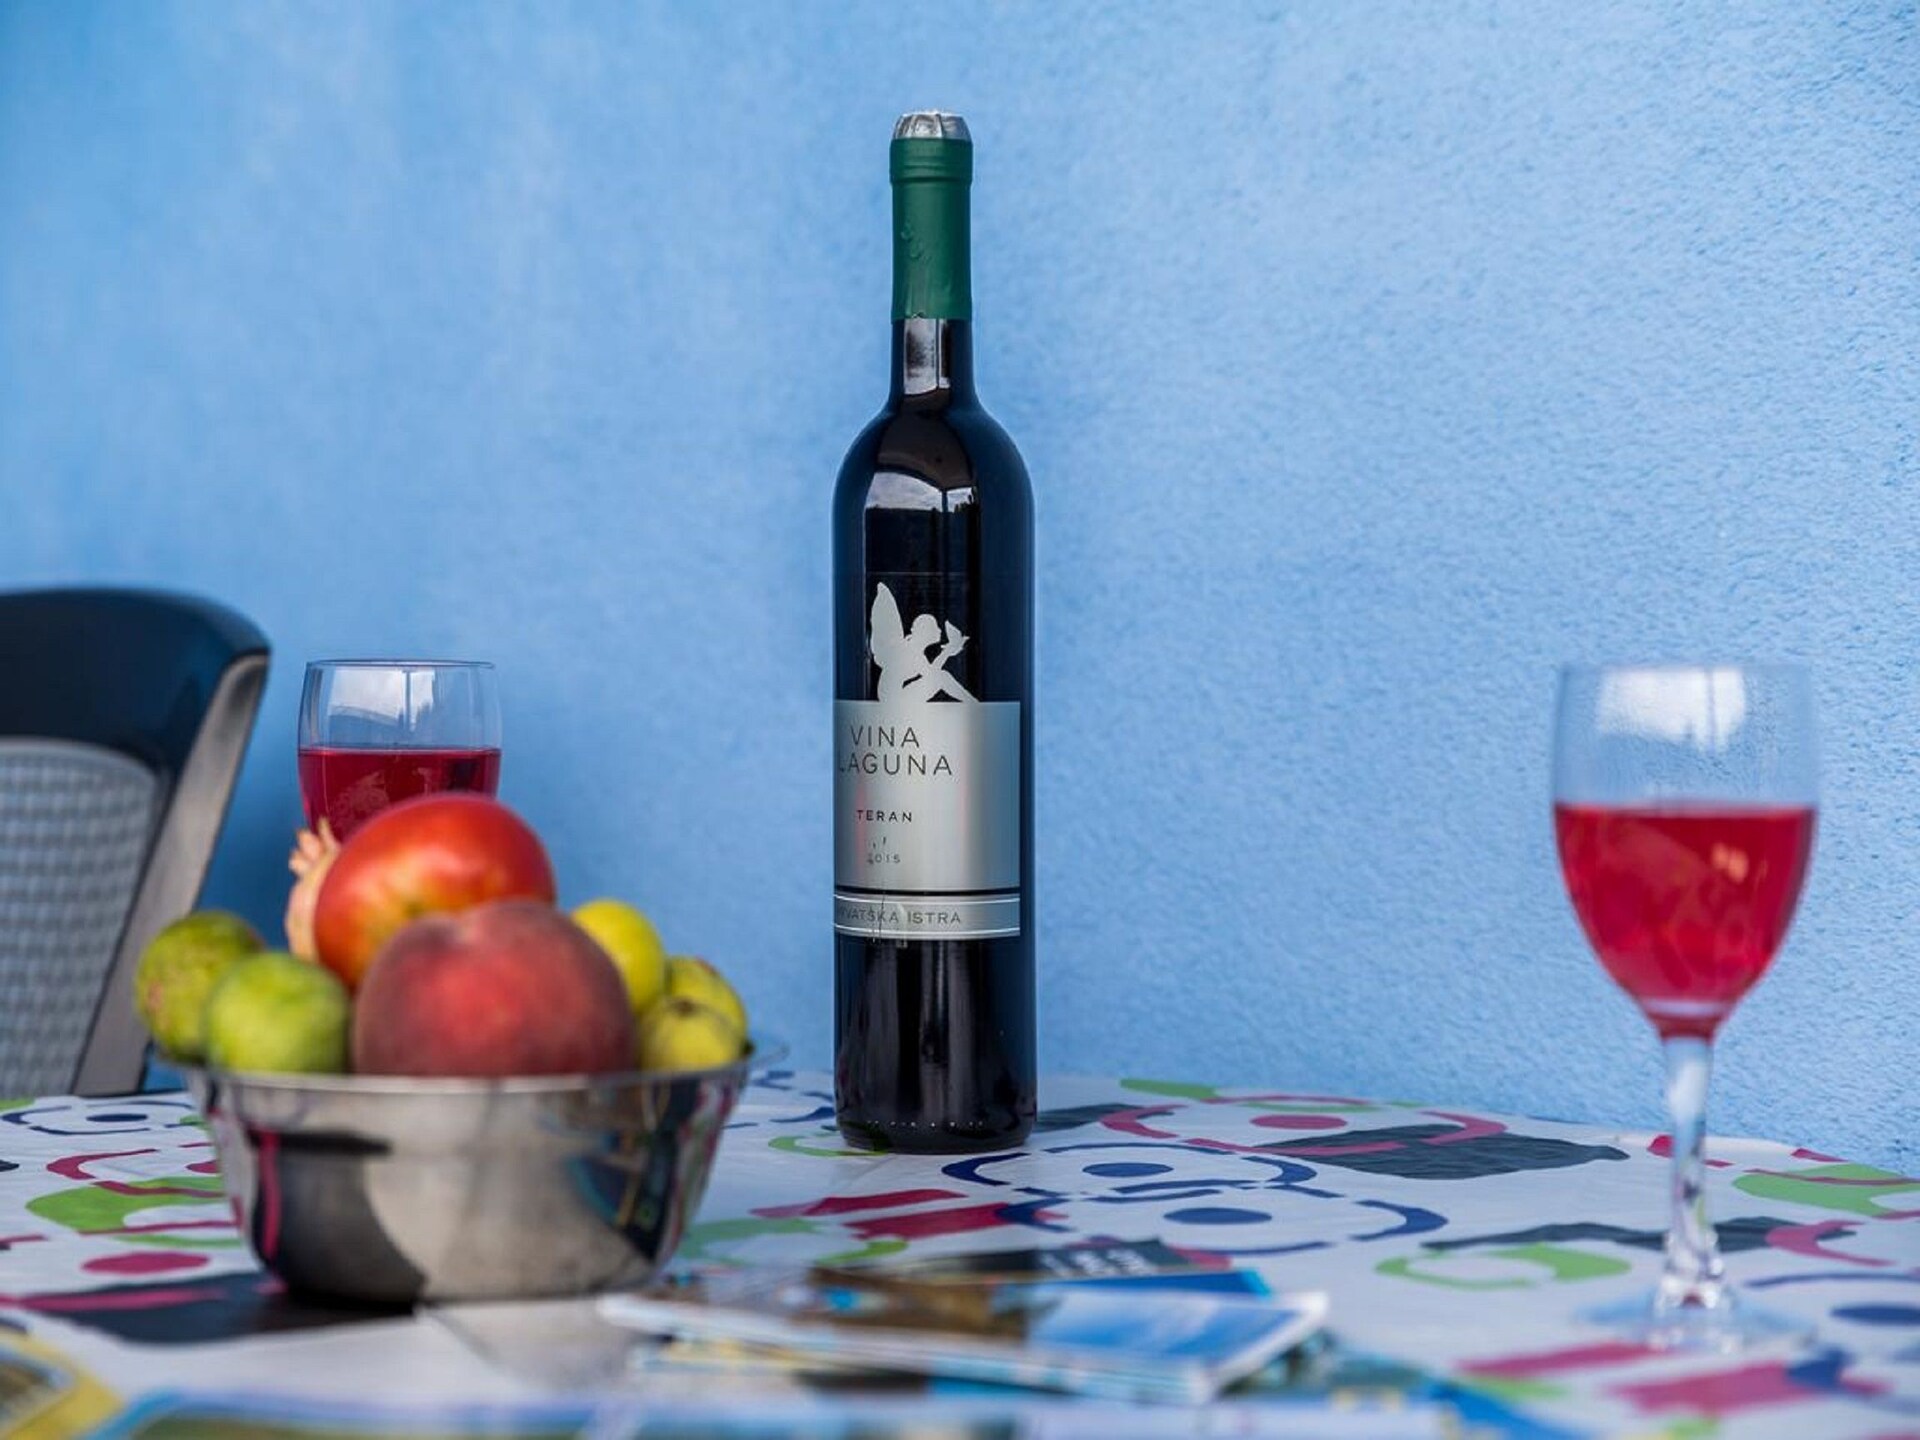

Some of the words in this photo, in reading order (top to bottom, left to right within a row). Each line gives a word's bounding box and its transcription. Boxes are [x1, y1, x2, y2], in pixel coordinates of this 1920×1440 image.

[850, 725, 920, 748] VINA
[856, 809, 913, 823] TERAN
[907, 911, 962, 925] ISTRA
